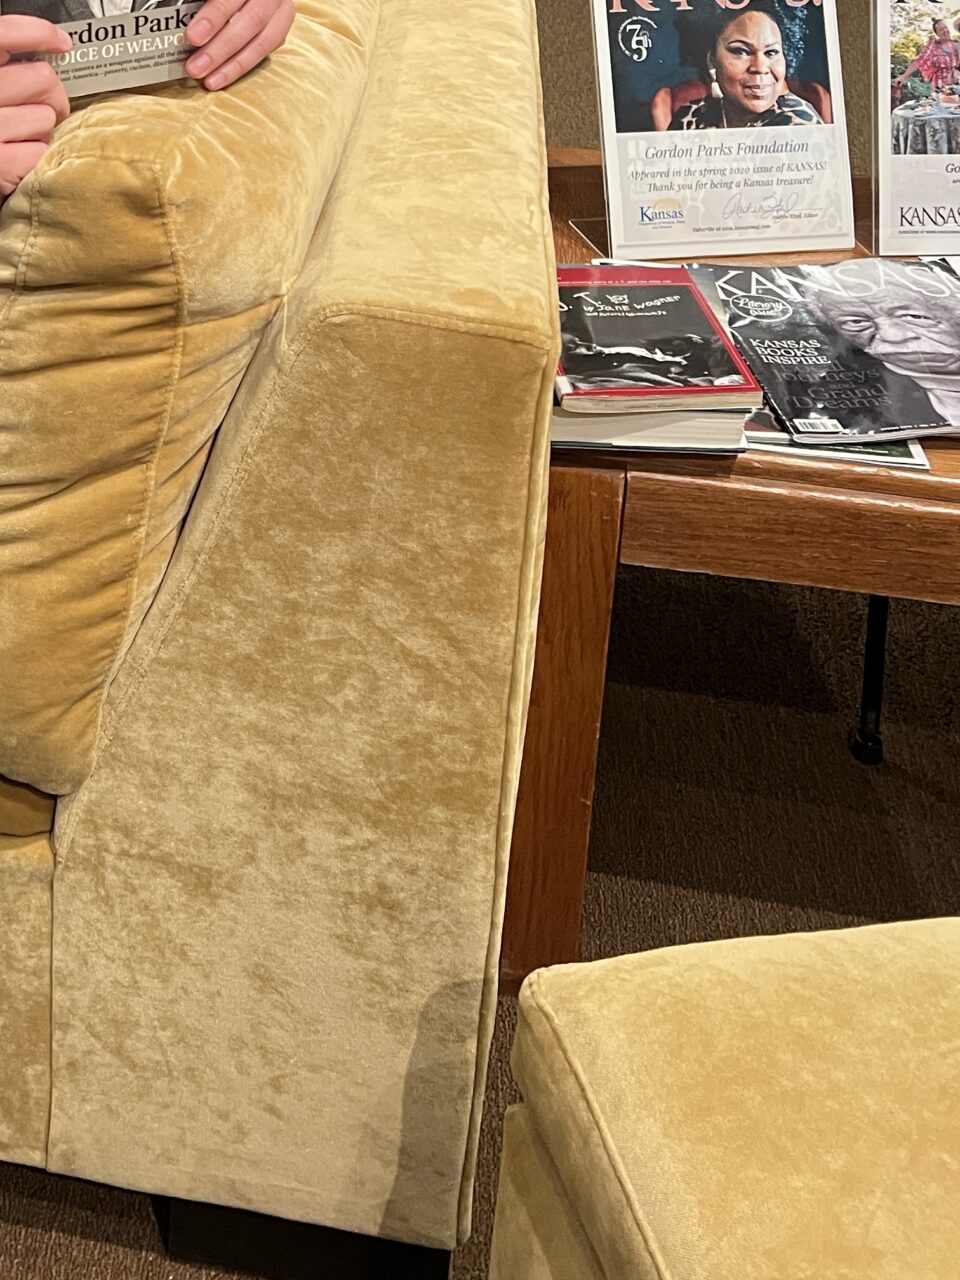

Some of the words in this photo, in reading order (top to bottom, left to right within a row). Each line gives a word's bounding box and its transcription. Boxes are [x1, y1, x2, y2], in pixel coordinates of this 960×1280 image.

[102, 42, 124, 58] OF
[126, 33, 185, 54] WEAPO
[71, 65, 94, 73] camera
[134, 54, 156, 63] against
[72, 72, 99, 80] America
[645, 143, 691, 160] Gordon
[696, 142, 733, 158] Parks
[737, 139, 809, 155] Foundation
[628, 167, 670, 180] Appeared
[672, 167, 681, 177] in
[683, 165, 696, 177] the
[698, 165, 727, 178] spring
[729, 166, 749, 175] 2020
[753, 164, 773, 174] issue
[775, 161, 786, 174] of
[786, 161, 827, 172] KANSAS!
[647, 182, 674, 193] Thank
[675, 183, 691, 193] you
[694, 180, 709, 193] for
[710, 179, 733, 191] being
[743, 178, 774, 188] Kansas
[776, 175, 814, 186] treasure!
[639, 206, 685, 222] Kansas
[899, 206, 960, 227] KANSA
[749, 338, 821, 348] KANSAS
[754, 347, 818, 357] BOOKS
[760, 355, 831, 365] INSPIRE
[772, 368, 881, 383] Journeys
[808, 383, 889, 399] Grand
